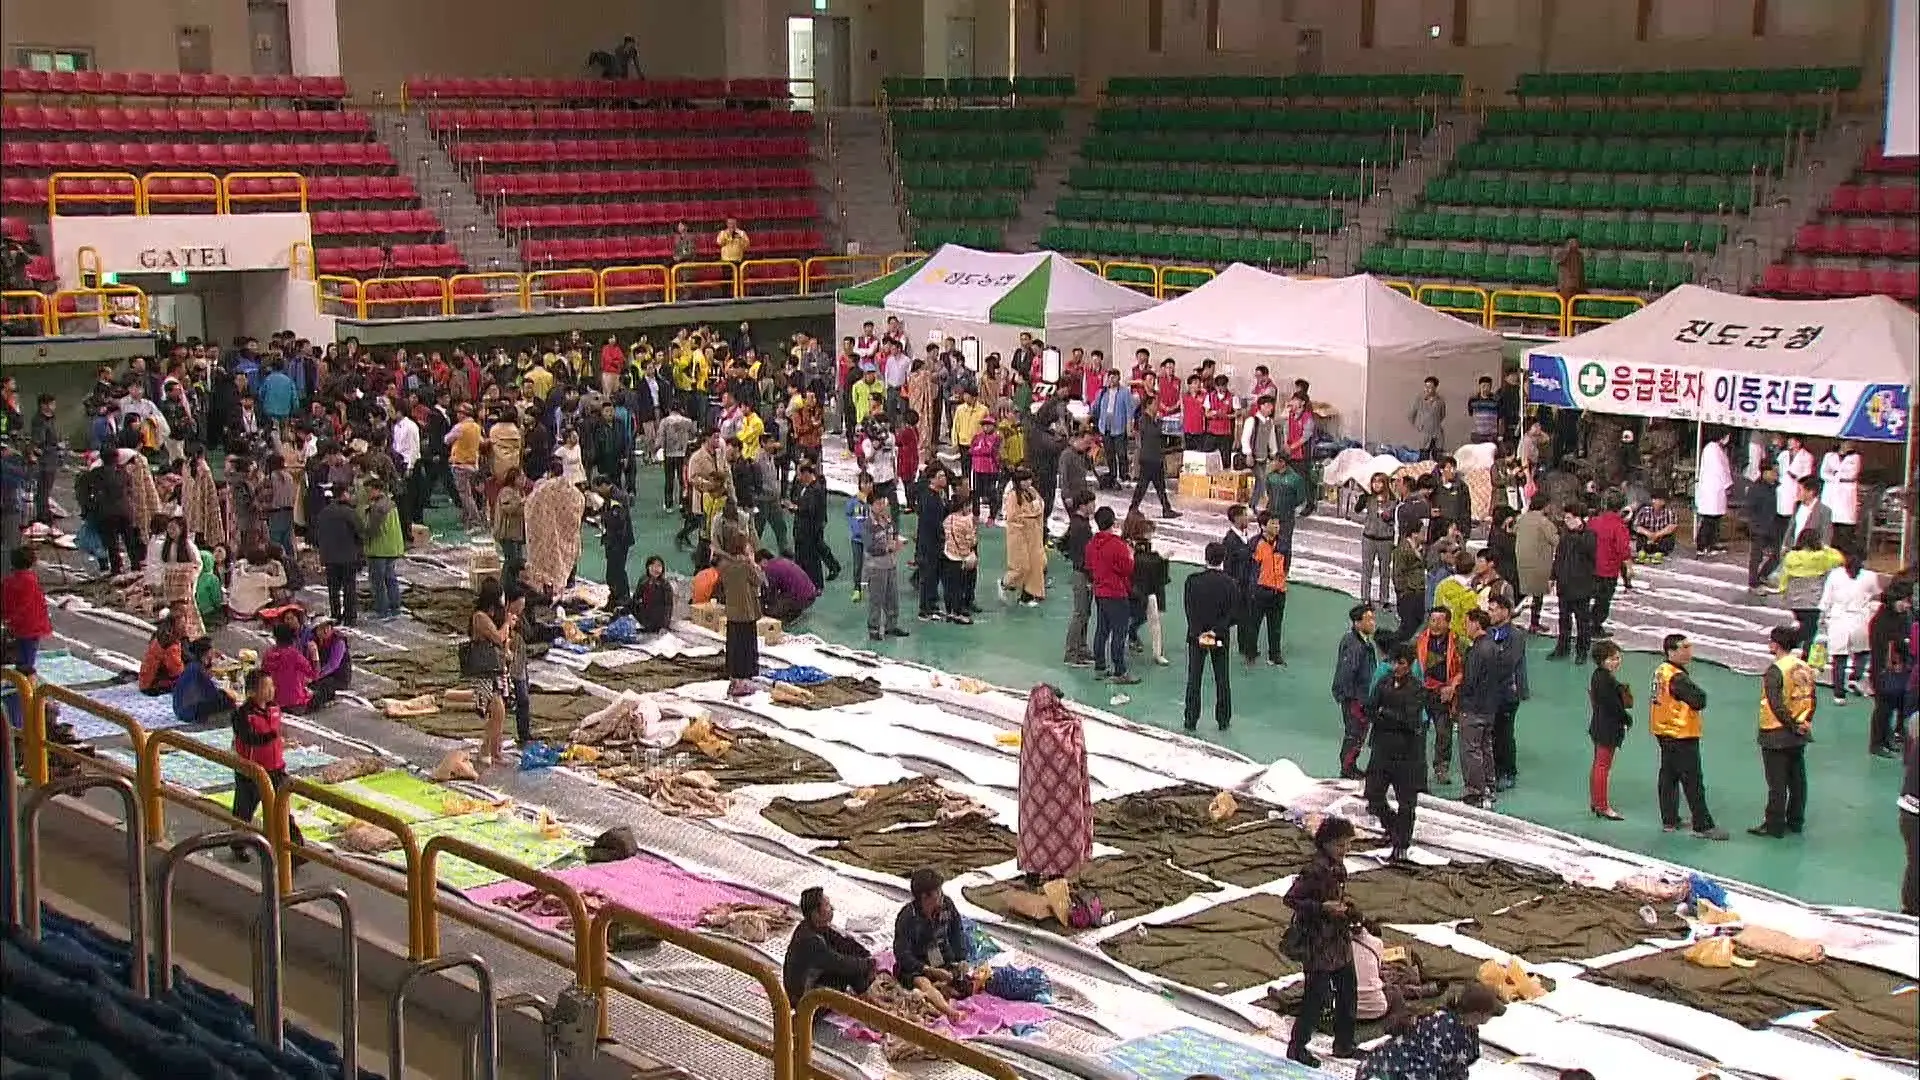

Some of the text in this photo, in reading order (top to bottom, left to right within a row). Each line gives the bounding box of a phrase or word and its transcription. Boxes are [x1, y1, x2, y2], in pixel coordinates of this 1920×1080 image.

[1675, 319, 1825, 350] 진도군청
[1611, 365, 1705, 407] 응급환자
[1714, 374, 1841, 418] 이동진료소
